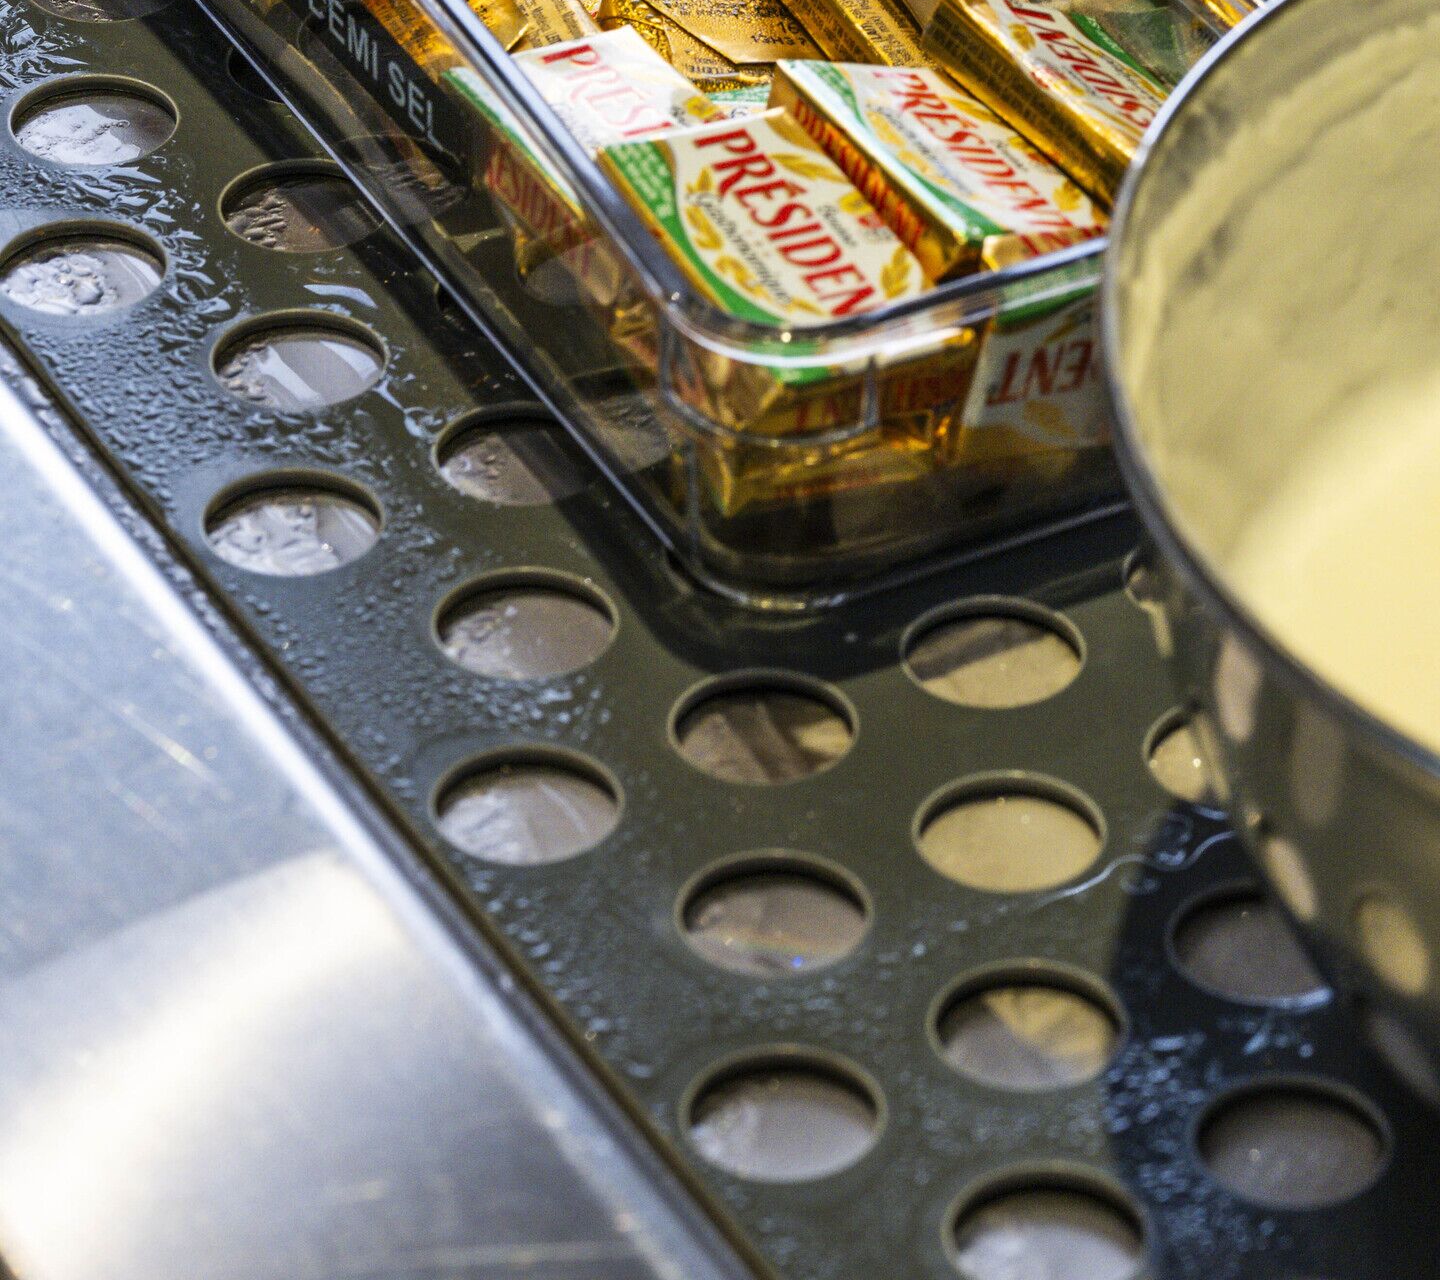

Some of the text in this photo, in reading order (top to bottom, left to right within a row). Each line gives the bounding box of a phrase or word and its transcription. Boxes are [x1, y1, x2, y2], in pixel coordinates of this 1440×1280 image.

[387, 66, 446, 151] SEL
[543, 43, 674, 137] PRÉSI
[872, 71, 1078, 231] PRÉSIDENT
[692, 128, 882, 317] PRÉSIDEN
